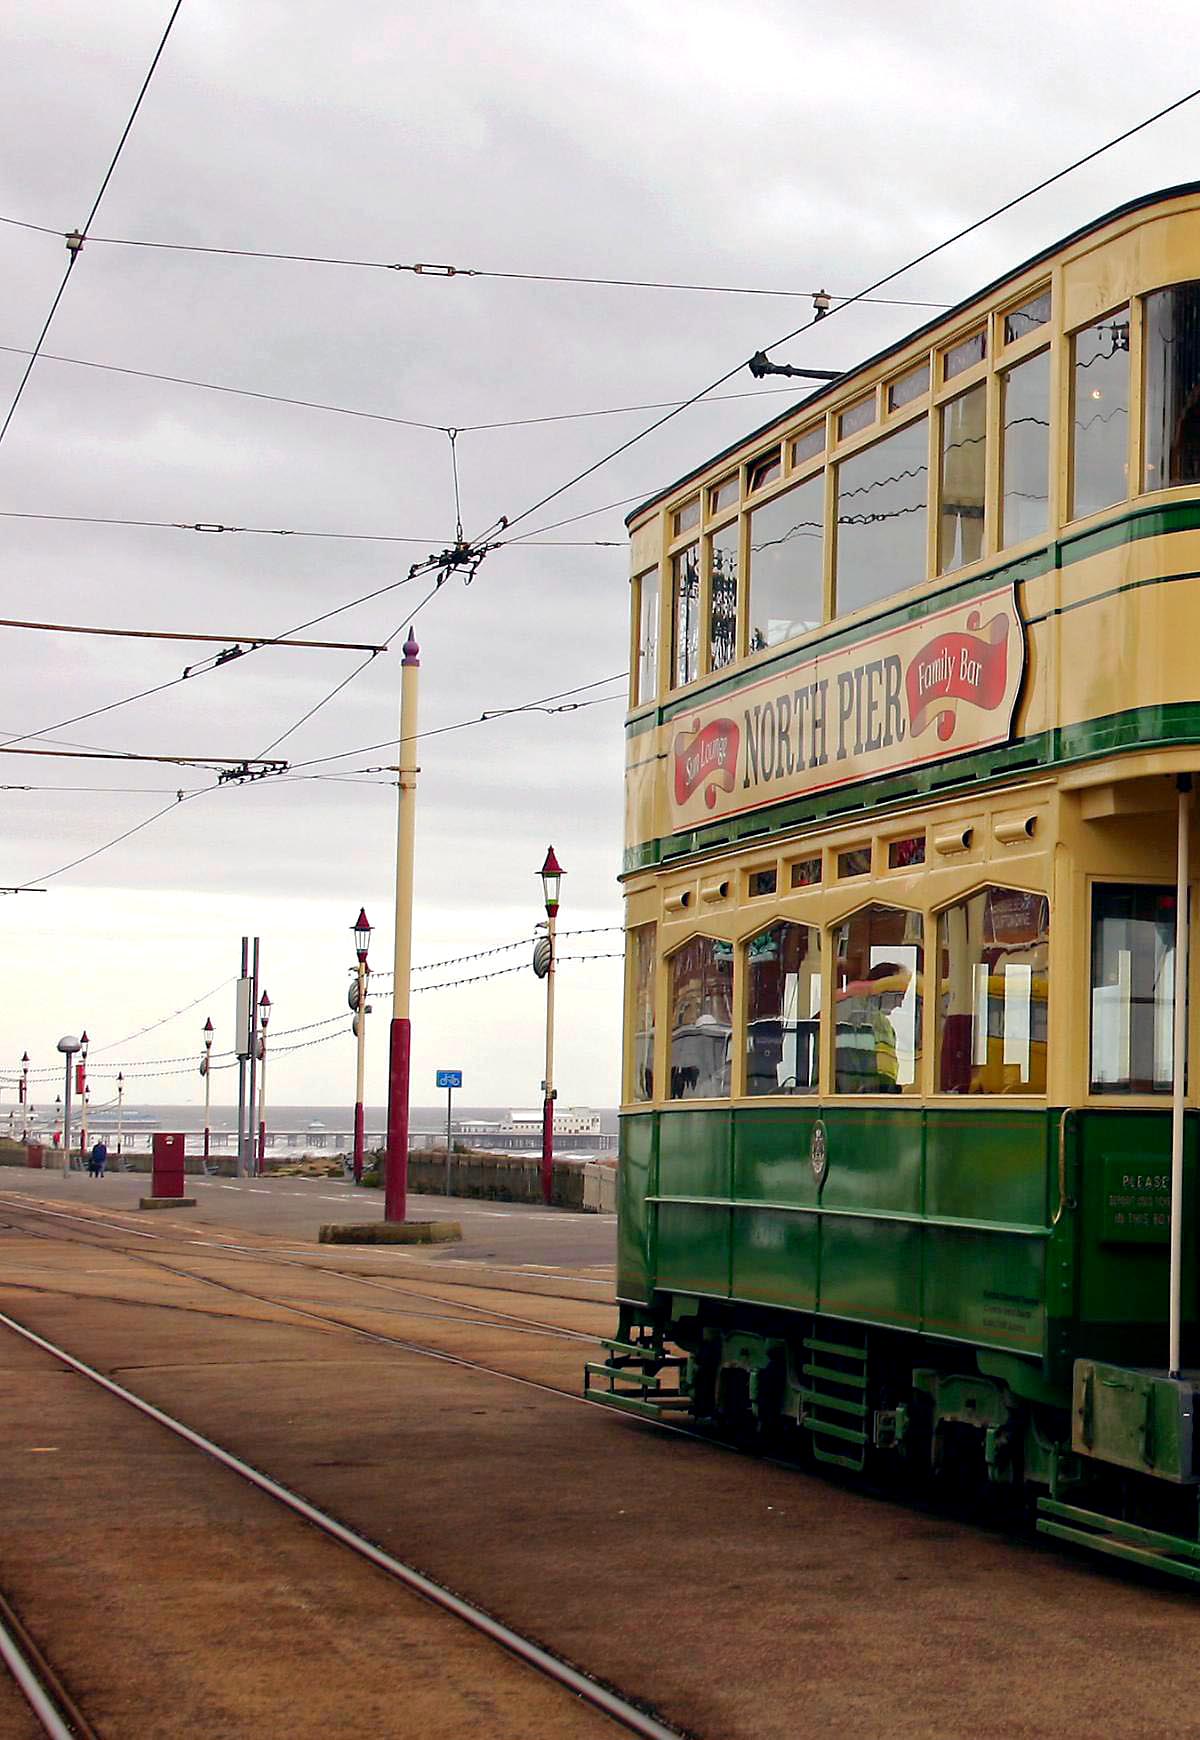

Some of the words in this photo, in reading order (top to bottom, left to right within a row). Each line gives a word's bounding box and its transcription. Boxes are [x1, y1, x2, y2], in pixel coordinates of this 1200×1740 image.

[918, 647, 956, 696] Family
[960, 648, 982, 687] Bar
[743, 678, 829, 789] NORTH
[836, 654, 906, 761] PIER
[701, 737, 728, 768] Lounge
[1122, 1175, 1169, 1189] PLEASE
